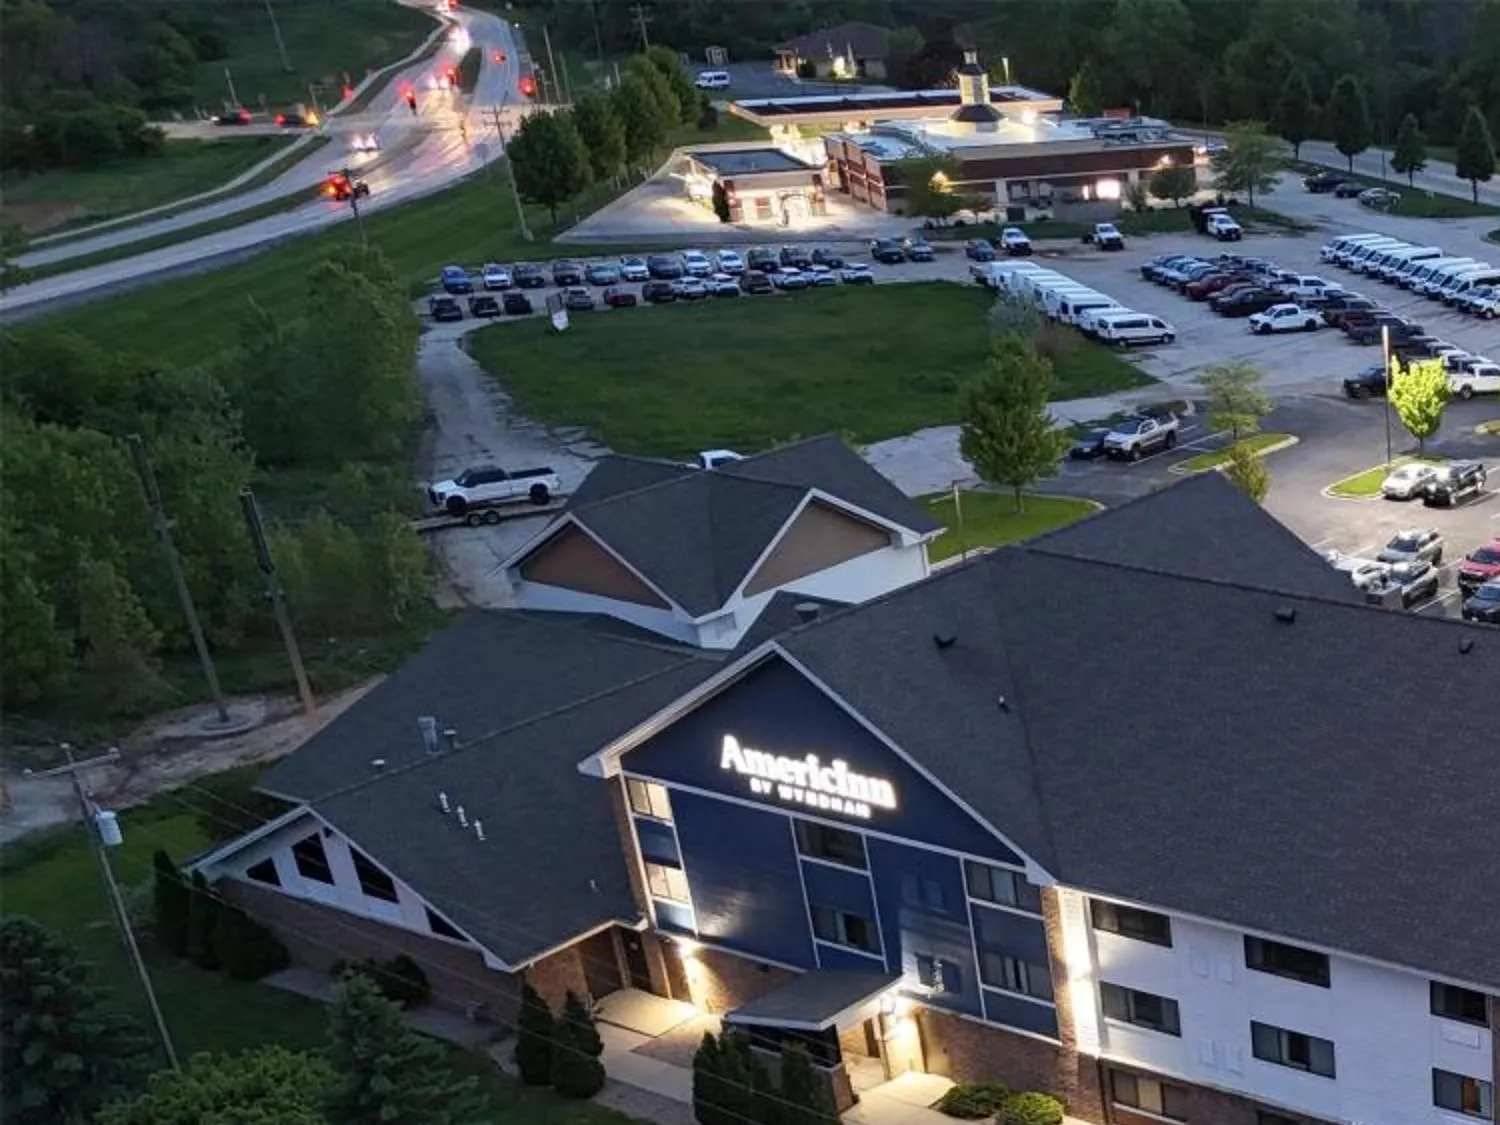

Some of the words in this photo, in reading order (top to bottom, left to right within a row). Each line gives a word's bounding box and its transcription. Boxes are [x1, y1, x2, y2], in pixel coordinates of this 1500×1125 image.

[720, 734, 898, 809] AmericInn
[749, 776, 772, 795] BY
[777, 783, 872, 819] WYNDHAM
